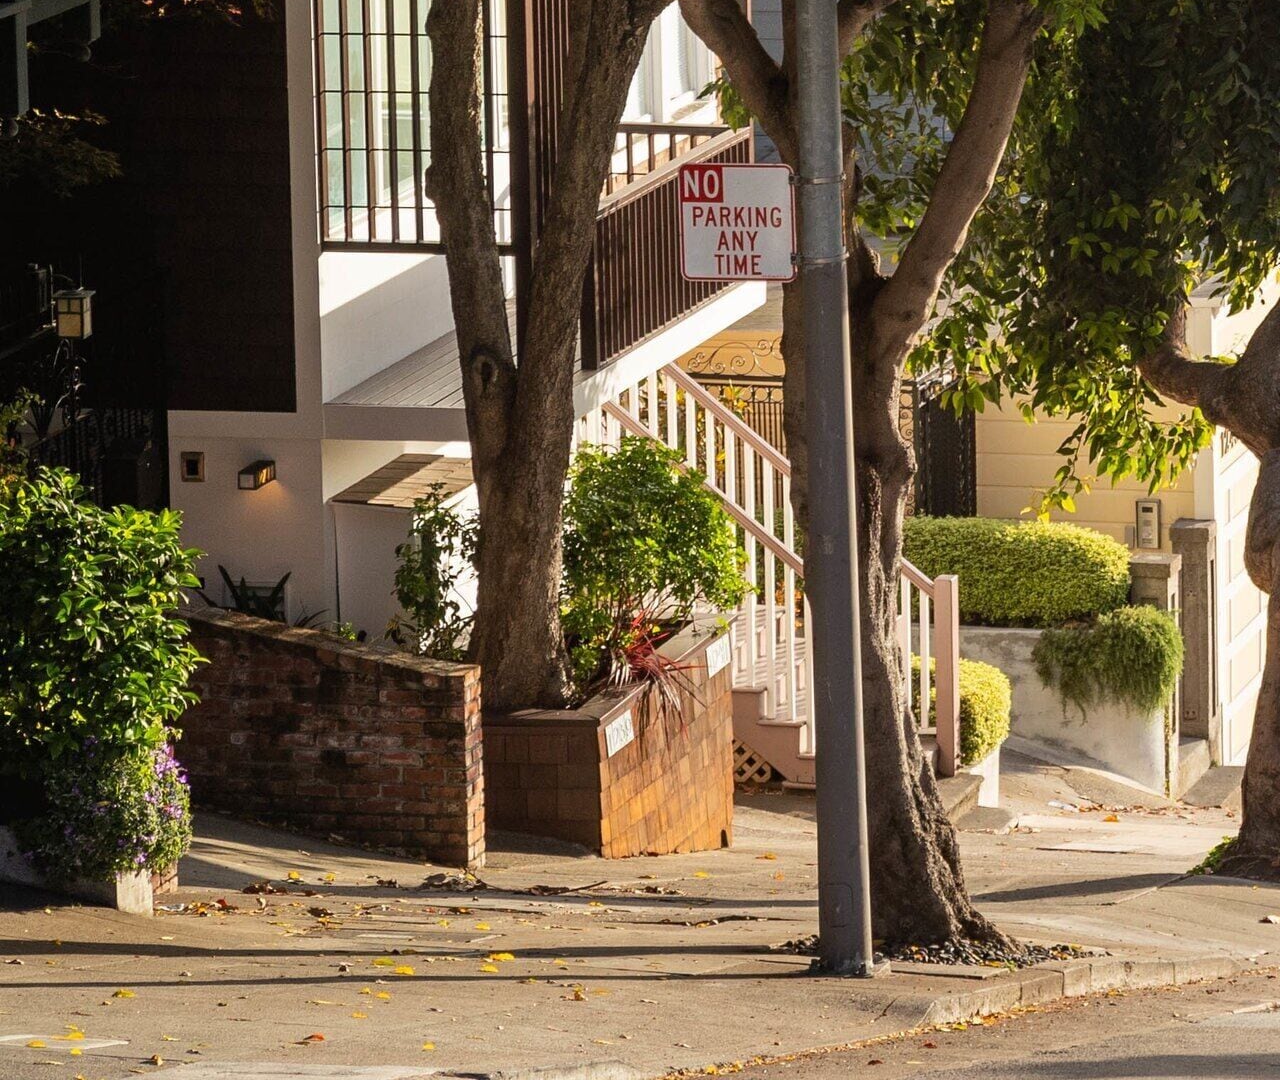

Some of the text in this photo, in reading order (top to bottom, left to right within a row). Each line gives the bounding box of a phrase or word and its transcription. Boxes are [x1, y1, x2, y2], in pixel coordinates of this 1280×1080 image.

[683, 170, 720, 199] NO
[692, 206, 782, 228] PARKING
[717, 230, 758, 252] ANY
[714, 254, 762, 276] TIME
